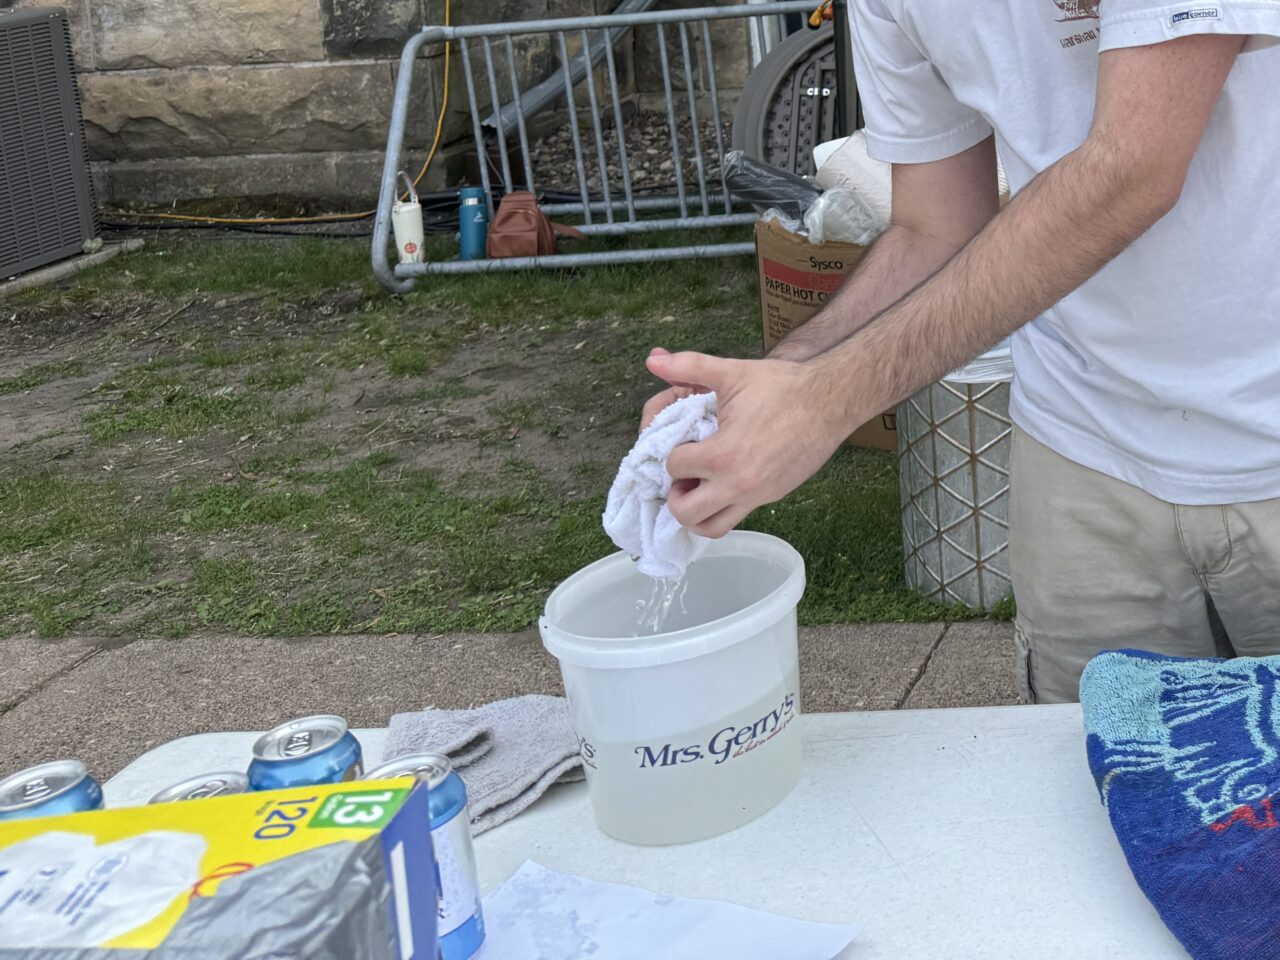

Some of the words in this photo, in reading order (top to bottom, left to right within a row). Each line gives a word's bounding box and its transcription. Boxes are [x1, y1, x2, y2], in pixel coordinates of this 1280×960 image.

[810, 256, 843, 271] Sysco
[765, 276, 791, 296] PAPER
[793, 286, 814, 301] HOT
[634, 743, 704, 768] Mrs.
[708, 693, 794, 764] Gerry's
[254, 796, 318, 839] 120
[333, 791, 393, 824] 13
